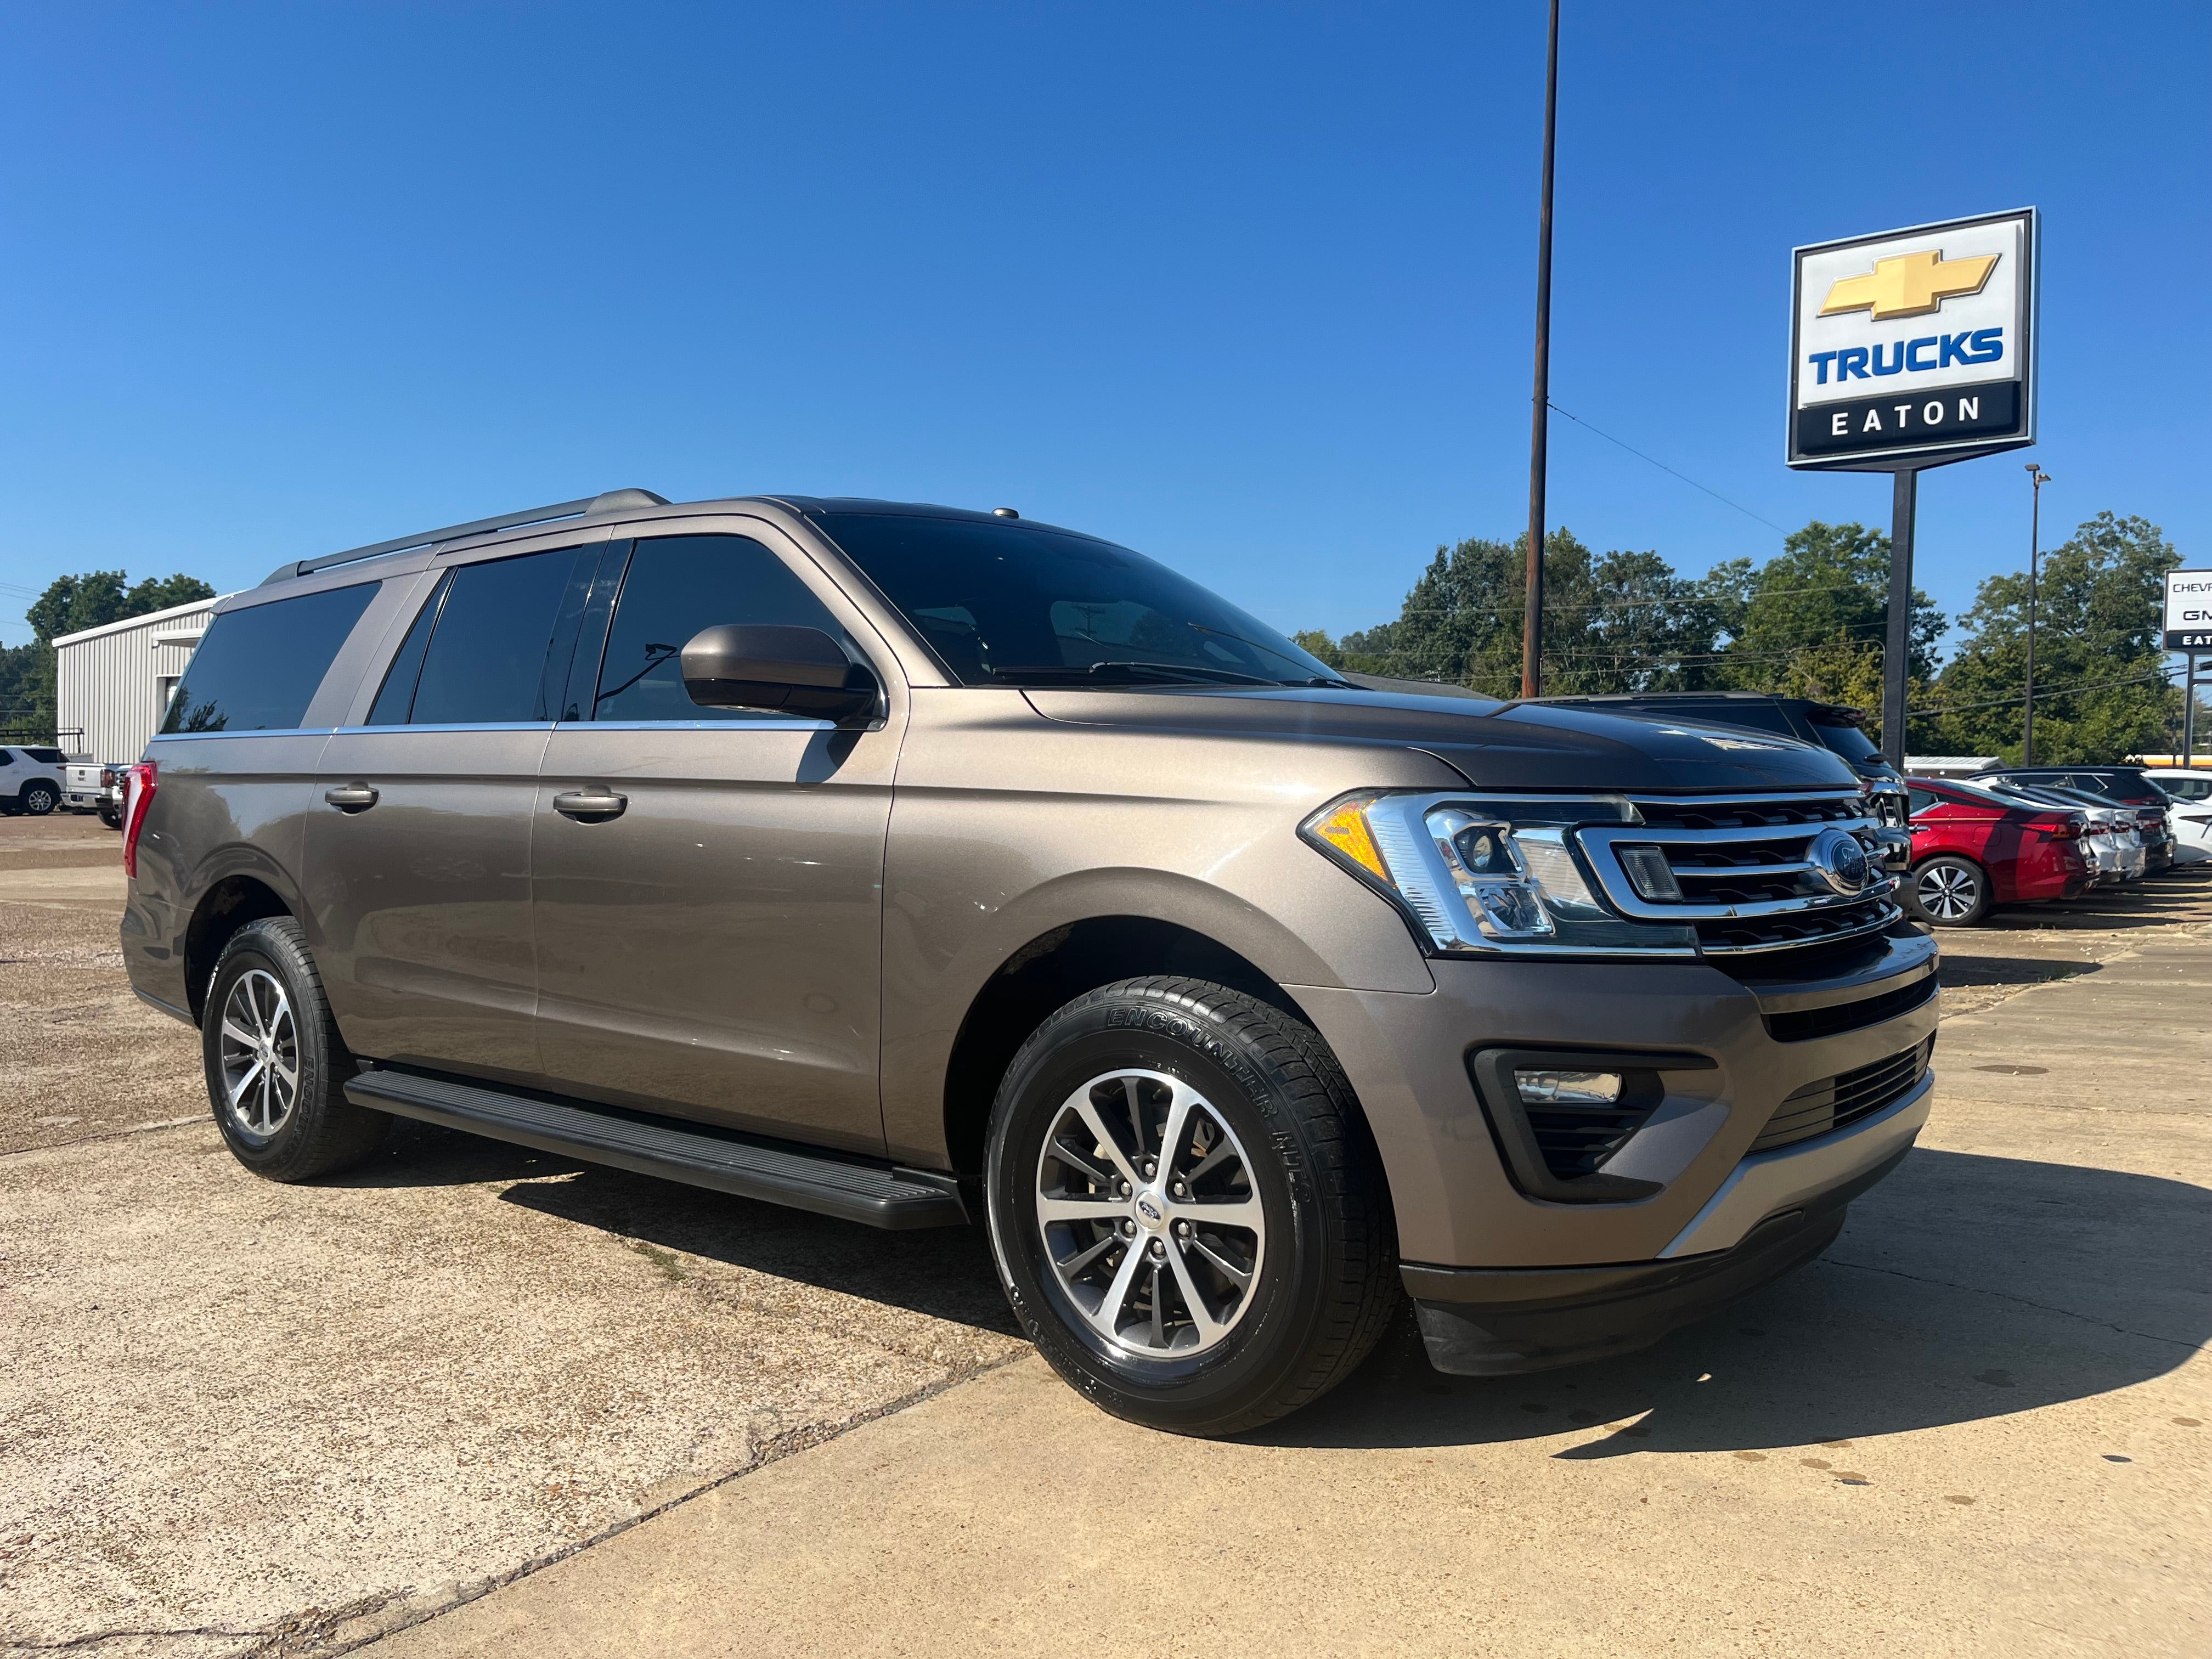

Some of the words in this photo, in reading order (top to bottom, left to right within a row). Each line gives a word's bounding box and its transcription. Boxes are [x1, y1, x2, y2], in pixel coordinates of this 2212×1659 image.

[1809, 327, 2004, 385] TRUCKS
[1831, 397, 1979, 436] EATON
[2182, 635, 2212, 645] EAT
[1107, 1008, 1278, 1118] ENCOUNTER
